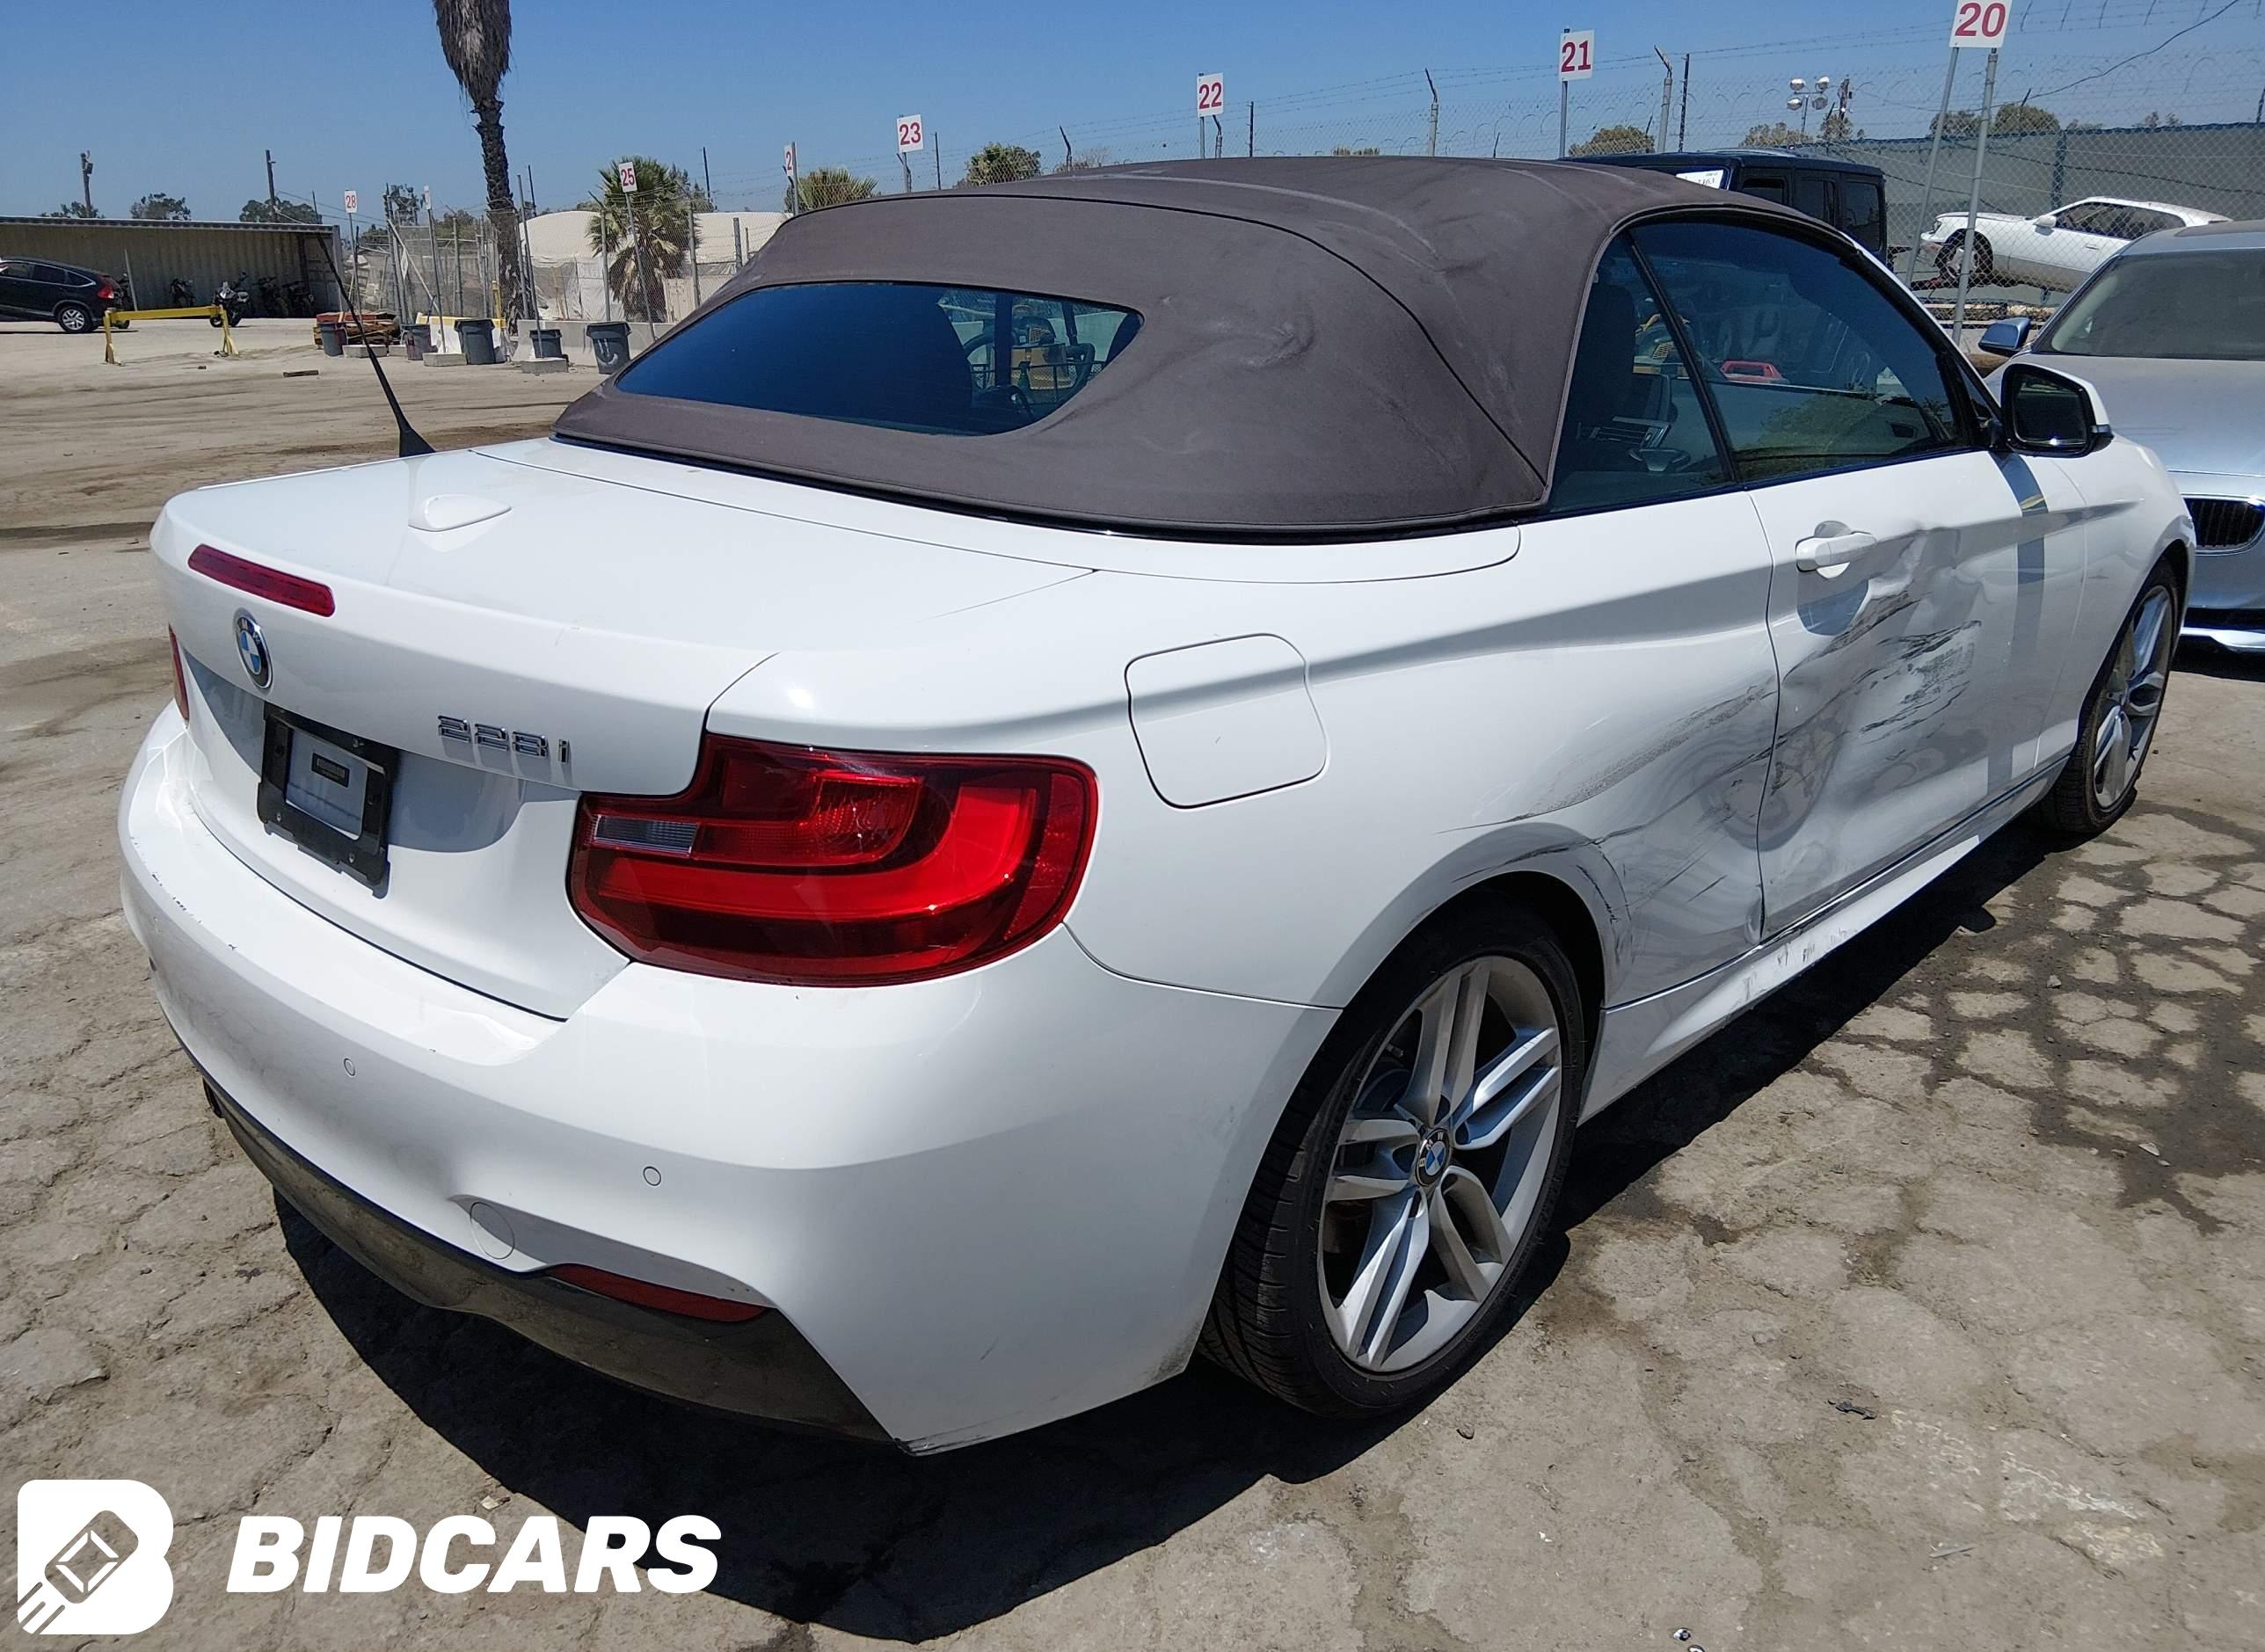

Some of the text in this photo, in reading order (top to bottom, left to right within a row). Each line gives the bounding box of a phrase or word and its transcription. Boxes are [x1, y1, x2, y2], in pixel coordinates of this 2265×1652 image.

[1955, 3, 2006, 38] 20
[1561, 40, 1591, 73] 21
[1198, 82, 1222, 110] 22
[899, 121, 921, 146] 23
[621, 167, 635, 187] 25
[346, 194, 357, 209] 28
[437, 714, 571, 764] 228i
[1417, 1131, 1445, 1168] BMW
